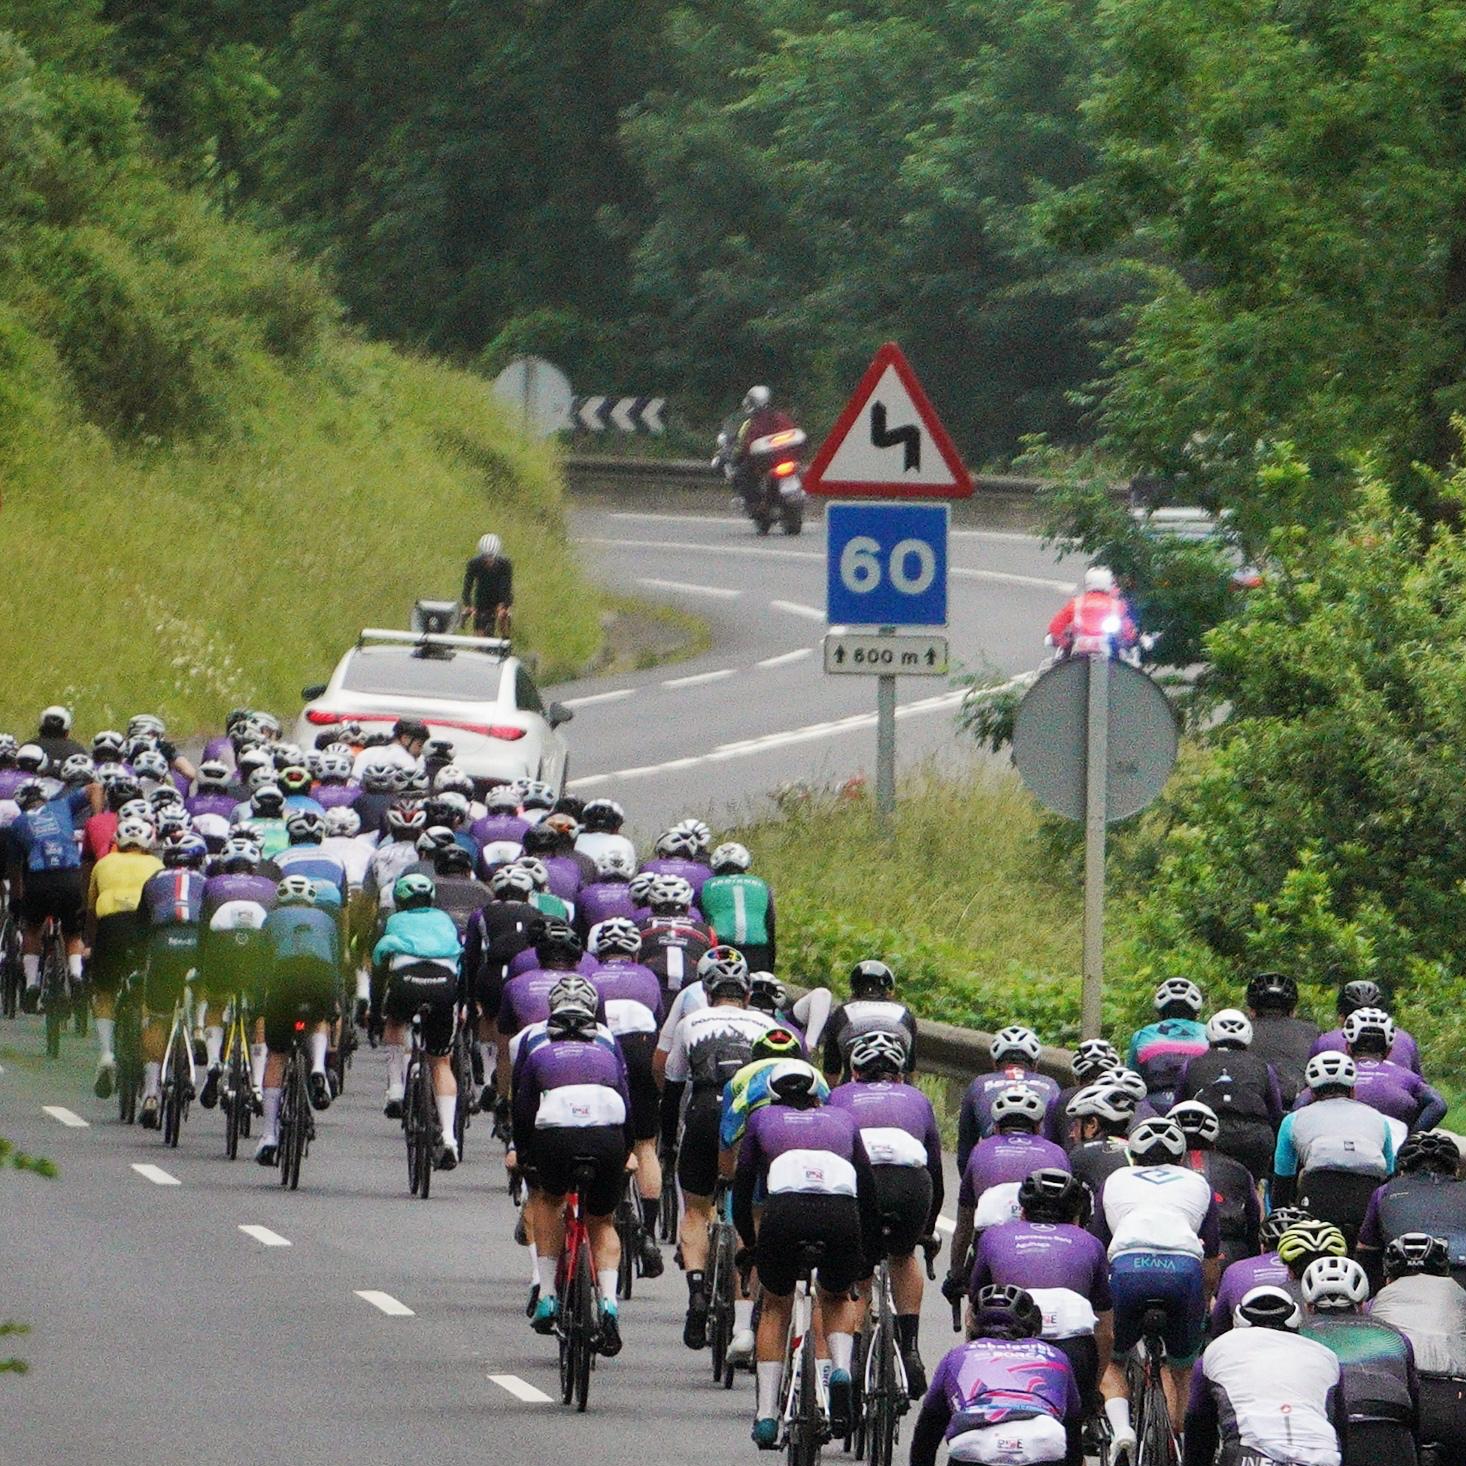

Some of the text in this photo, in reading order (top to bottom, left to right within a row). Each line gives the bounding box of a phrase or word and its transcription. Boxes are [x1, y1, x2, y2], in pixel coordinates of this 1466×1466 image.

[840, 536, 936, 594] 60
[902, 651, 918, 665] m
[1133, 1257, 1176, 1271] EKANA
